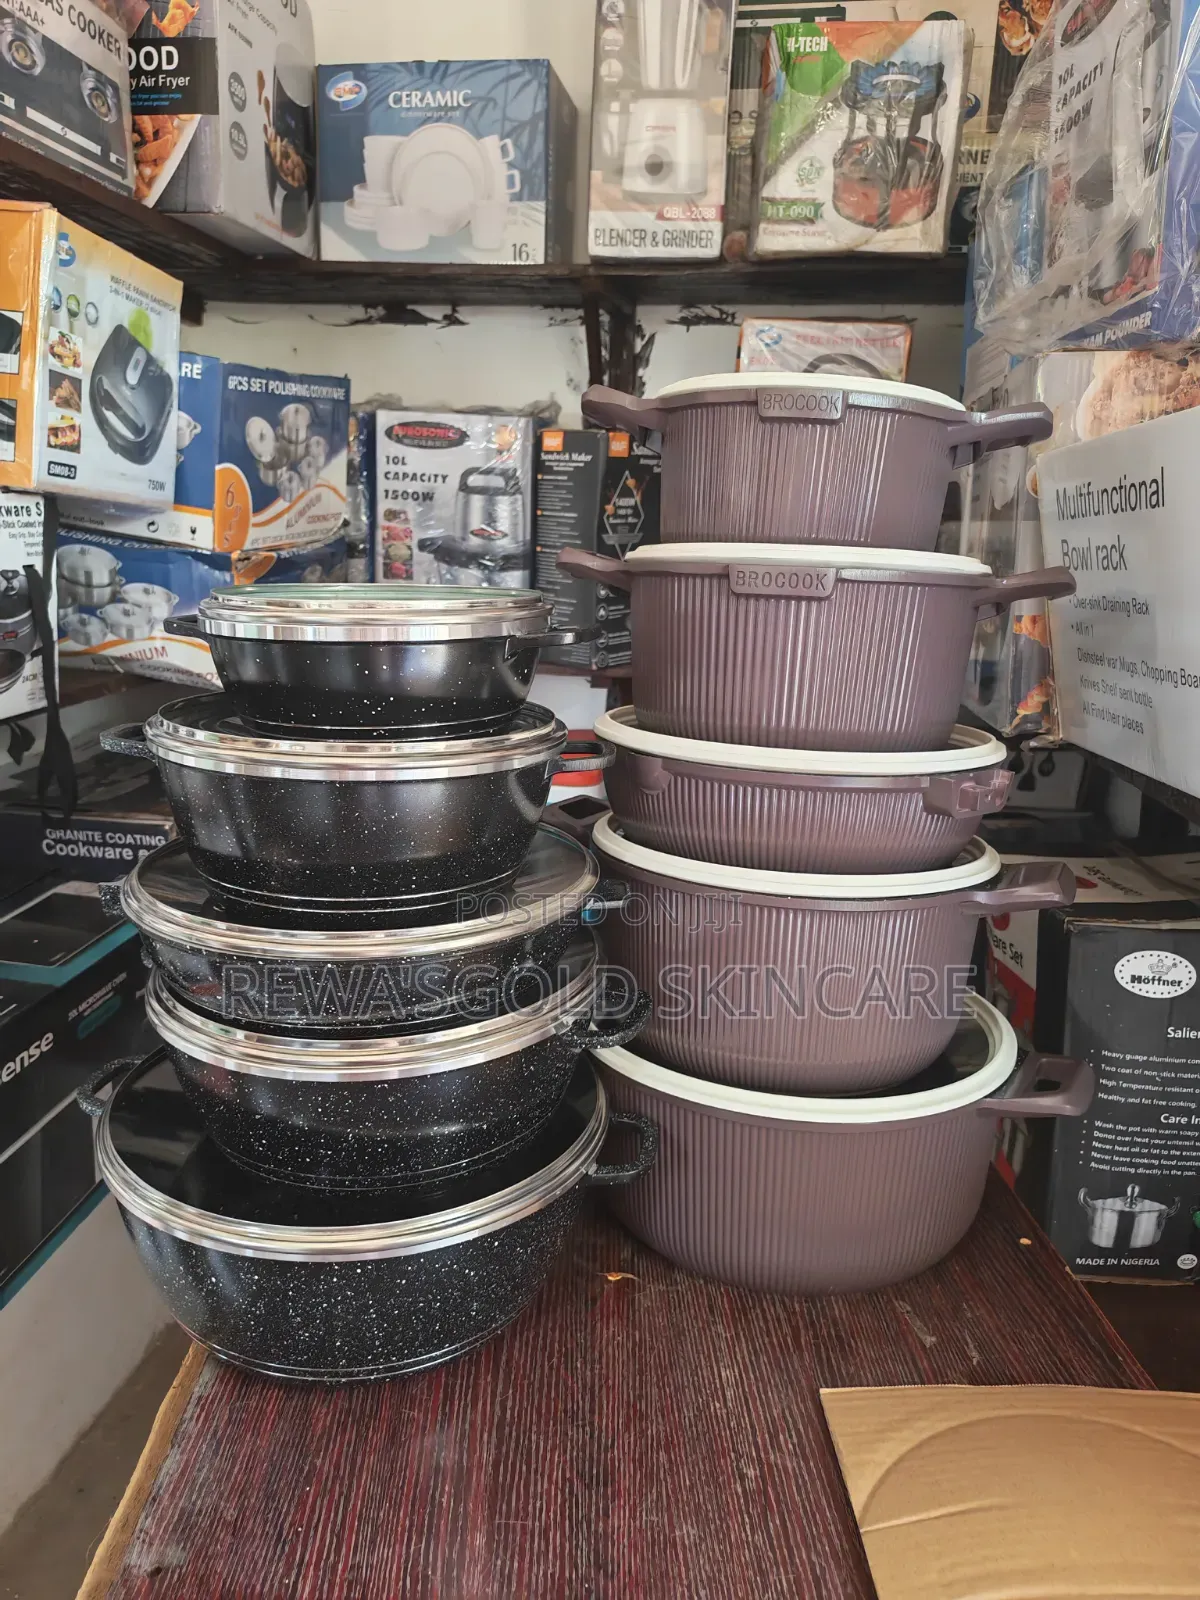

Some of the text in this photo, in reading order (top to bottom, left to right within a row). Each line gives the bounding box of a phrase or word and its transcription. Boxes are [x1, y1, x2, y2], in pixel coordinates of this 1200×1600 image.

[67, 4, 123, 61] COOKER
[139, 74, 157, 87] Air
[158, 74, 191, 90] Fryer
[388, 89, 472, 108] CERAMIC
[594, 228, 714, 249] BLENDER & GRINDER
[511, 243, 530, 263] 16
[1104, 310, 1153, 345] POUNDER
[250, 378, 267, 392] SET
[762, 393, 839, 414] BROCOOK
[385, 455, 407, 466] 10L
[148, 479, 166, 492] 750W
[384, 471, 449, 484] CAPACITY
[225, 481, 236, 508] 6
[383, 489, 436, 502] 1500W
[1056, 466, 1165, 521] Multifunctional
[1061, 535, 1127, 572] Bowl rack
[735, 570, 827, 591] BROCOOK
[1102, 595, 1131, 618] Draining
[1132, 597, 1150, 615] Rack
[1141, 660, 1178, 689] Chopping
[1122, 712, 1144, 735] places
[46, 828, 166, 847] GRANITE COATING
[42, 839, 134, 860] Cookware
[1009, 942, 1024, 969] Set
[1130, 974, 1183, 987] Höffner
[0, 1032, 54, 1085] ense
[1101, 1050, 1125, 1060] Heavy
[1125, 1054, 1148, 1062] guage
[1148, 1055, 1187, 1064] aluminium
[1101, 1063, 1116, 1073] Two
[1099, 1078, 1194, 1094] High Temperature resistant
[1098, 1092, 1125, 1104] Healthy
[1153, 1098, 1167, 1106] free
[1160, 1113, 1188, 1125] Care
[1094, 1120, 1114, 1129] Wash
[1115, 1122, 1127, 1131] the
[1128, 1125, 1141, 1133] pot
[1141, 1126, 1157, 1134] with
[1179, 1129, 1200, 1138] soapy
[1092, 1140, 1113, 1150] Never
[1114, 1144, 1130, 1153] heat
[1130, 1145, 1140, 1153] oil
[1133, 1135, 1149, 1143] heat
[1149, 1138, 1166, 1146] your
[1090, 1151, 1112, 1161] Never
[1112, 1154, 1131, 1162] leave
[1131, 1155, 1160, 1166] cooking
[1160, 1158, 1177, 1166] food
[1089, 1161, 1110, 1171] Avoid
[1111, 1165, 1136, 1174] cutting
[1136, 1167, 1162, 1176] directly
[1075, 1257, 1105, 1266] MADE
[1120, 1258, 1160, 1266] NIGERIA
